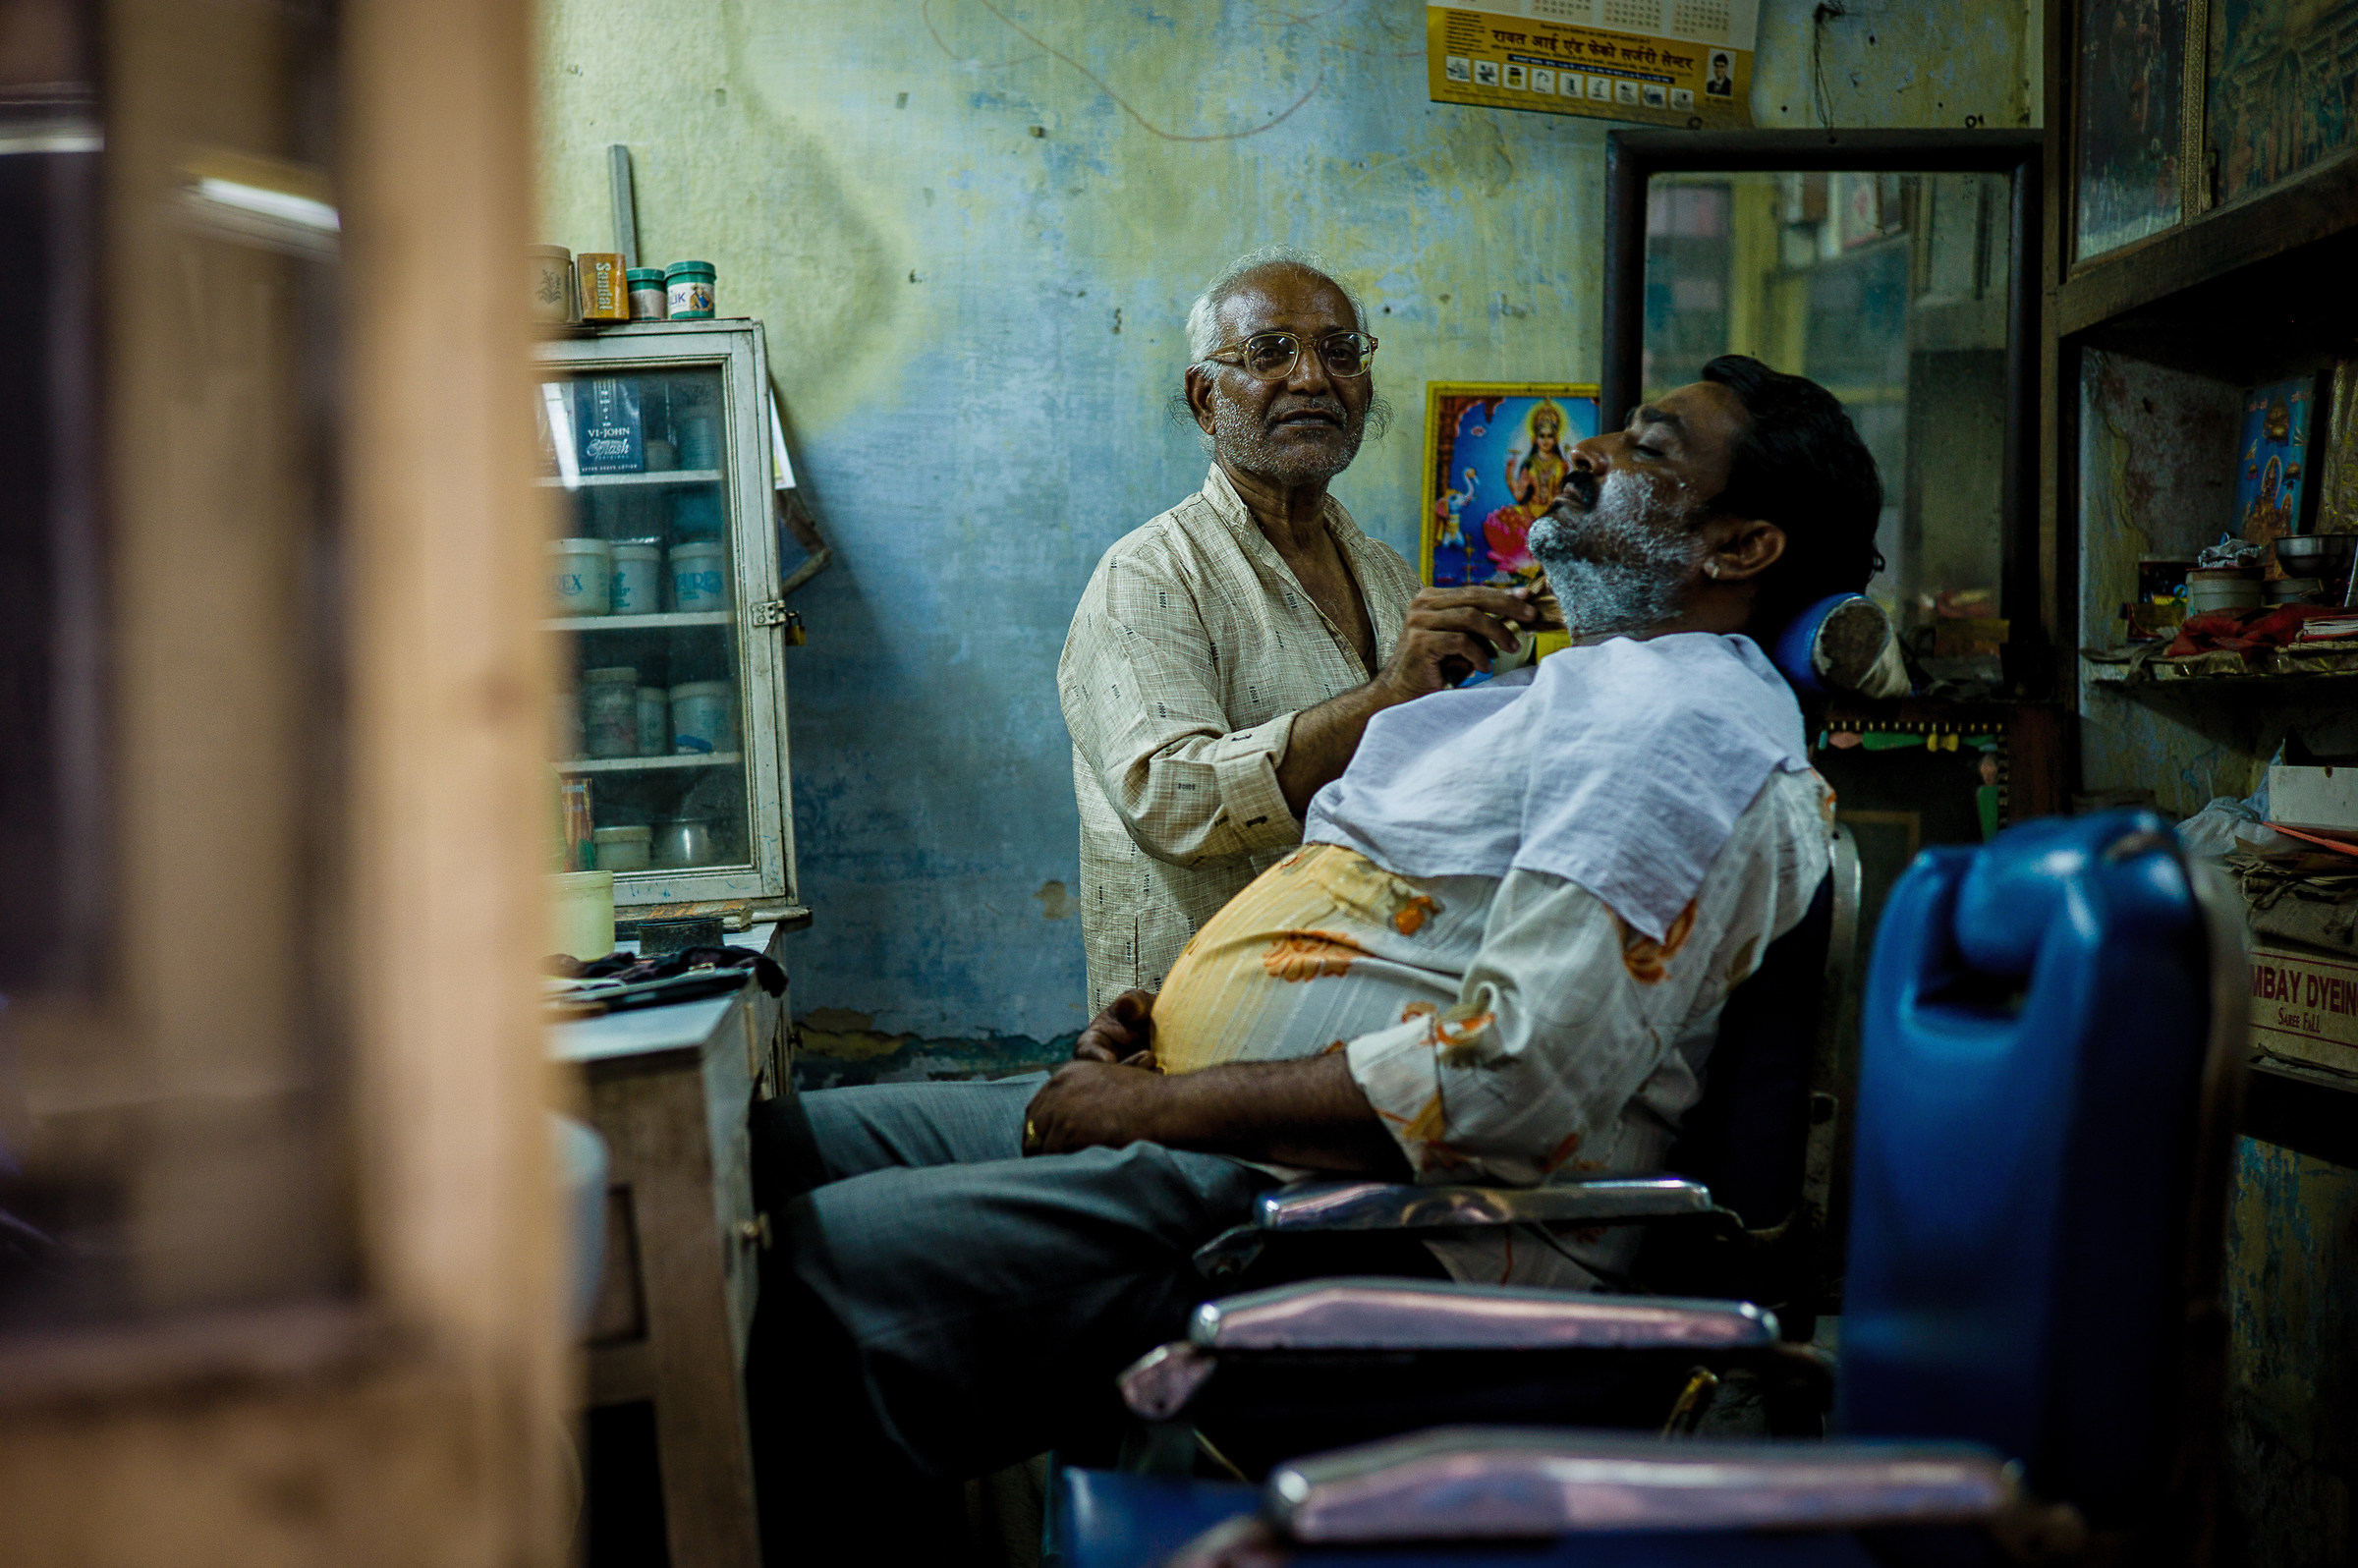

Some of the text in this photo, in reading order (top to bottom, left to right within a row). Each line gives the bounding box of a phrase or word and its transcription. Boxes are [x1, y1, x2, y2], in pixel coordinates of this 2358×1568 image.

[1532, 33, 1557, 52] आई
[595, 262, 613, 310] Sandal
[588, 426, 631, 439] VI-JOHN
[587, 437, 630, 459] Splash
[2250, 964, 2358, 1017] MBAY DYEIN
